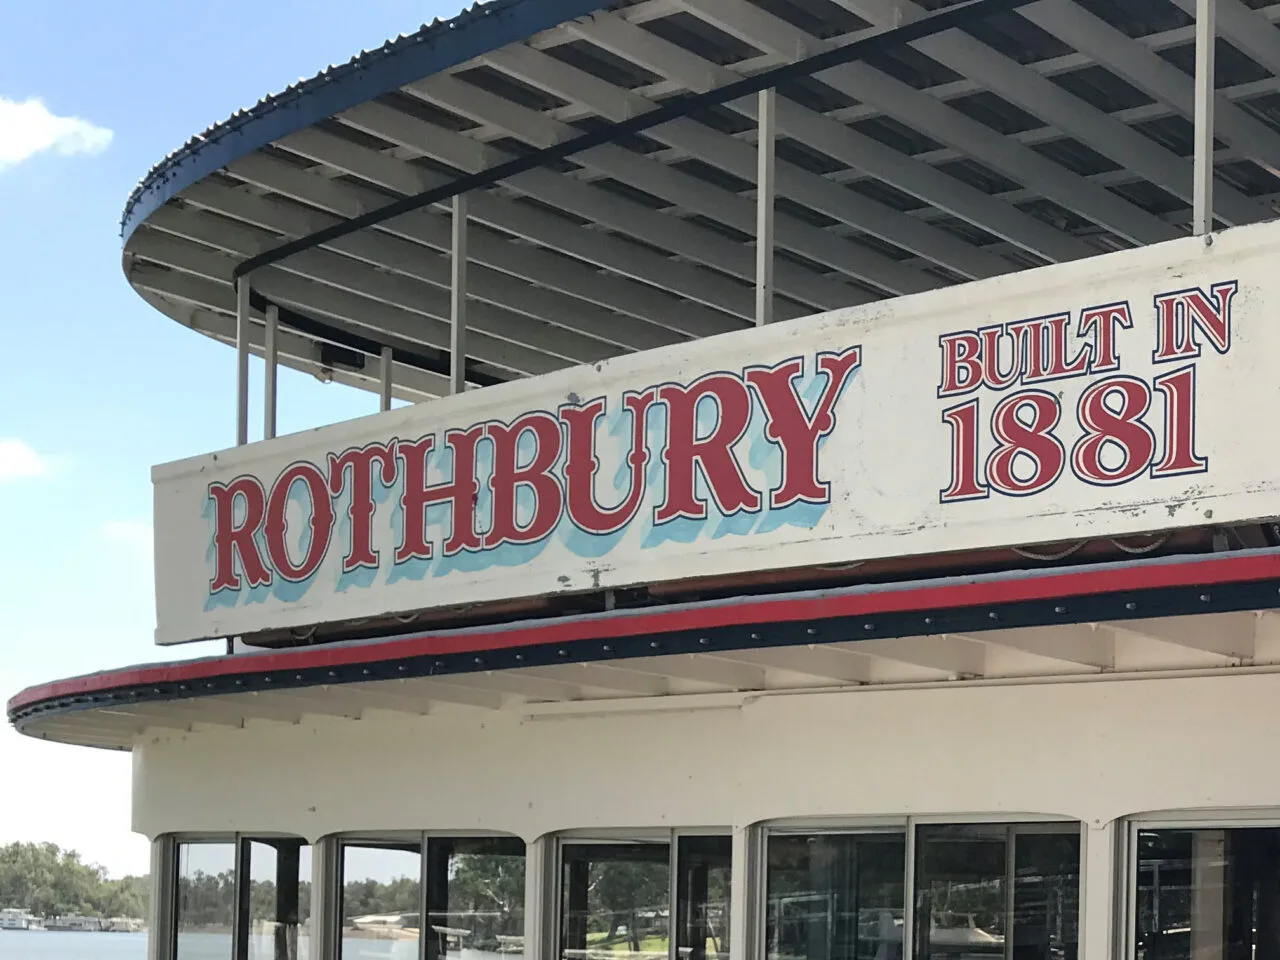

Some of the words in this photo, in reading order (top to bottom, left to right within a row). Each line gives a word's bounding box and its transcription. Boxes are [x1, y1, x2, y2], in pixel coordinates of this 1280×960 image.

[937, 300, 1134, 399] BUILT
[1152, 280, 1238, 364] IN
[207, 344, 863, 596] ROTHBURY
[939, 363, 1208, 503] 1881
